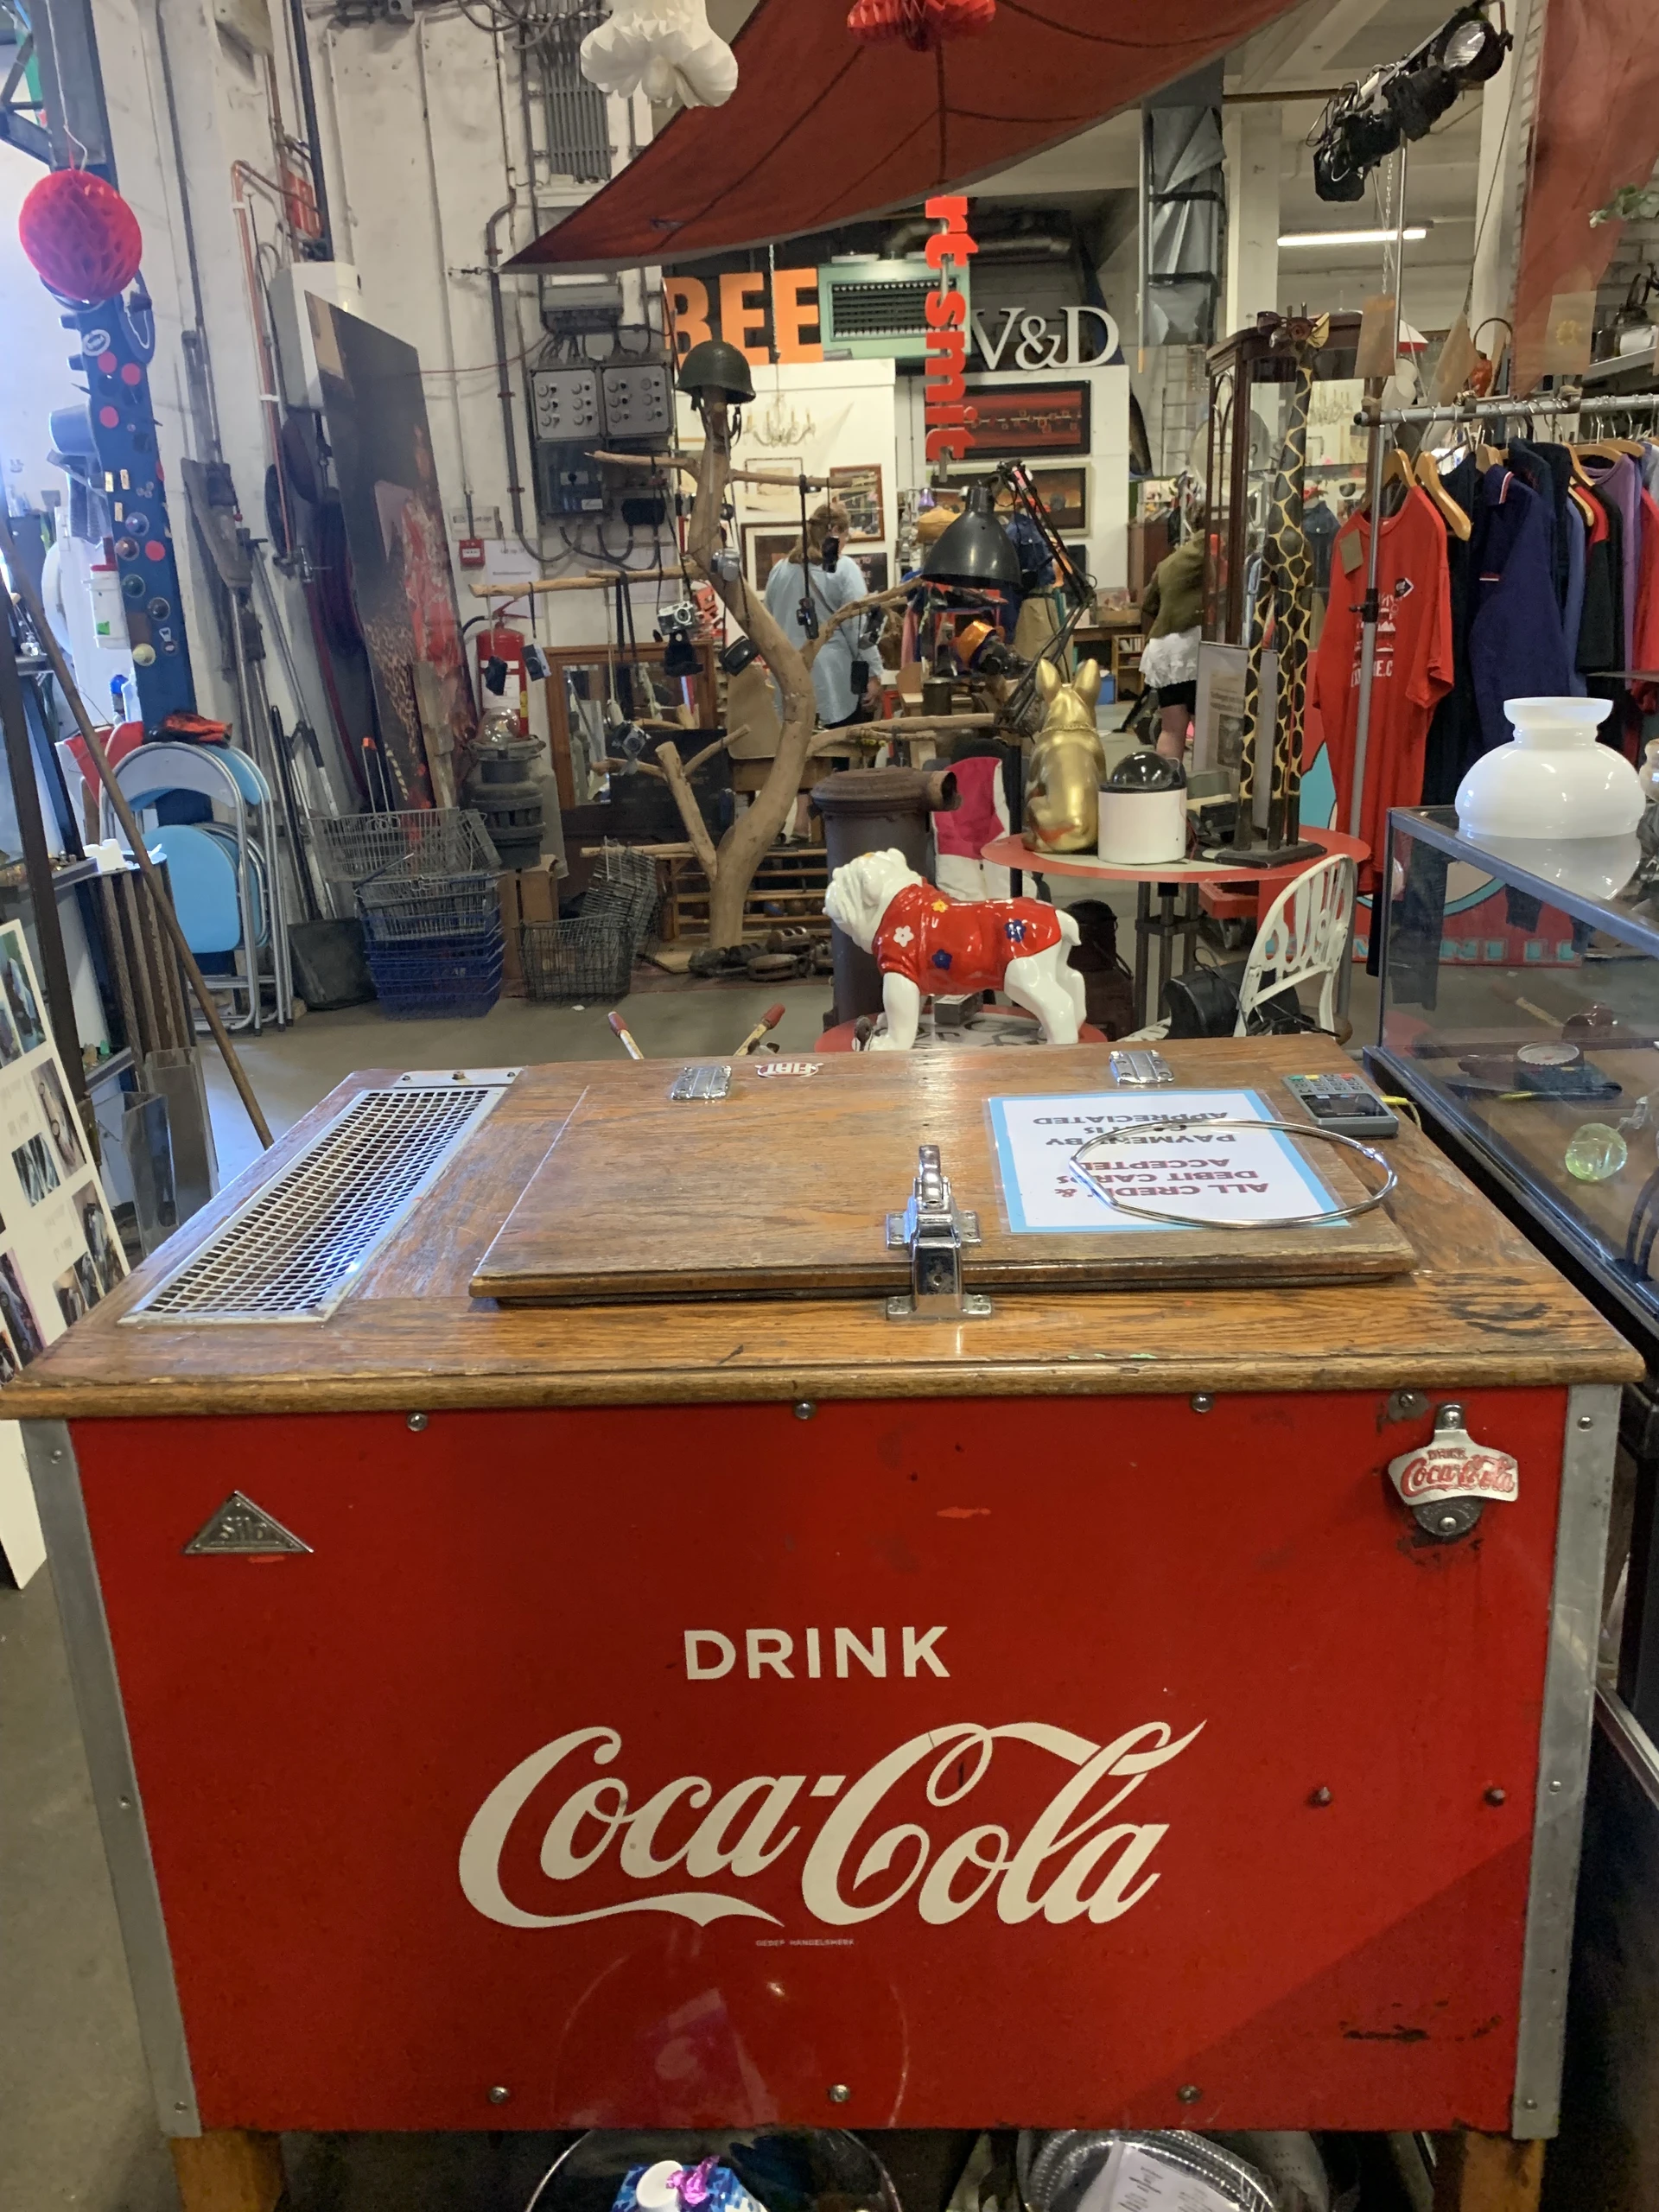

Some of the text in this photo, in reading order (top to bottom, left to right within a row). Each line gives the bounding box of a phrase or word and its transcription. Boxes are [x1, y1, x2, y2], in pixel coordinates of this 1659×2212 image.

[663, 268, 823, 372] BEE
[971, 306, 1119, 371] V&D
[925, 291, 978, 462] smit
[763, 1063, 813, 1075] FIAT
[1033, 1112, 1229, 1125] APPRECIATED
[1084, 1126, 1103, 1135] IS
[1046, 1137, 1084, 1146] BY
[1054, 1183, 1268, 1198] ALL CREDI &
[1056, 1170, 1259, 1184] DEBIT CARS
[1400, 1454, 1516, 1497] Coca-Cola
[683, 1625, 950, 1681] DRINK
[459, 1718, 1208, 1928] Coca-Cola
